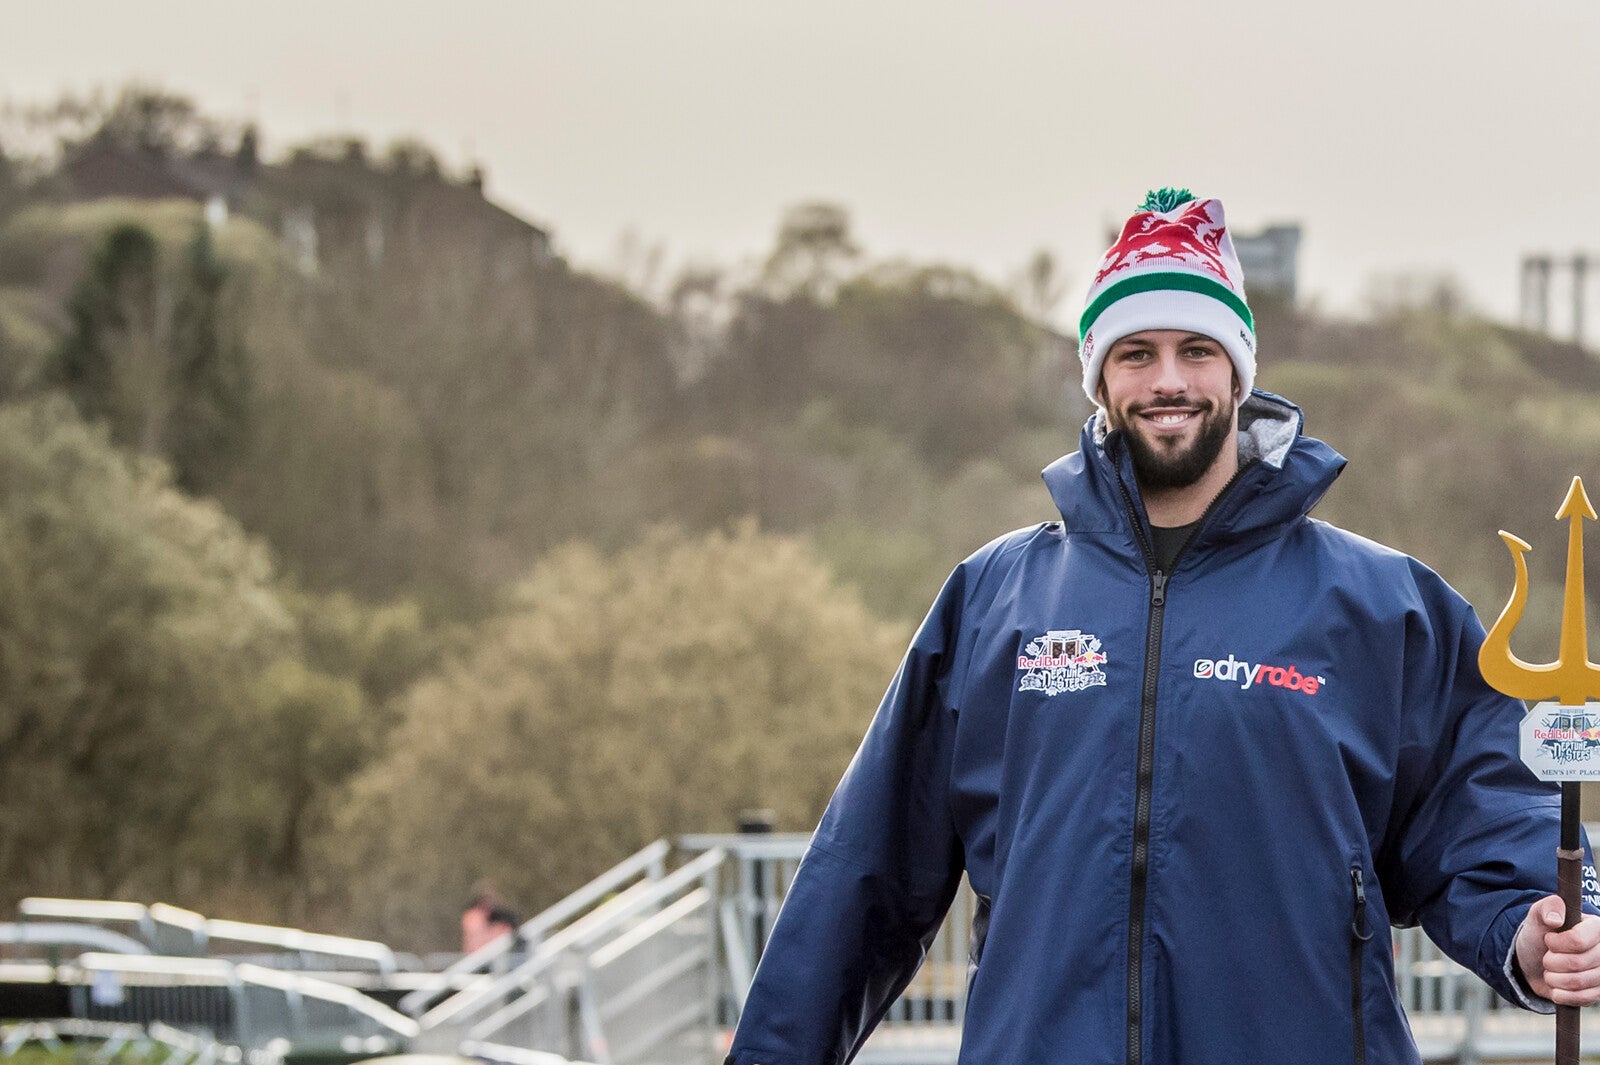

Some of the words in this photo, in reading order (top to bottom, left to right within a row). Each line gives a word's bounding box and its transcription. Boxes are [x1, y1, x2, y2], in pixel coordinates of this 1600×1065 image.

[1019, 655, 1042, 667] Red
[1044, 654, 1066, 666] Bull
[1534, 728, 1554, 739] Red
[1555, 728, 1575, 739] Bull
